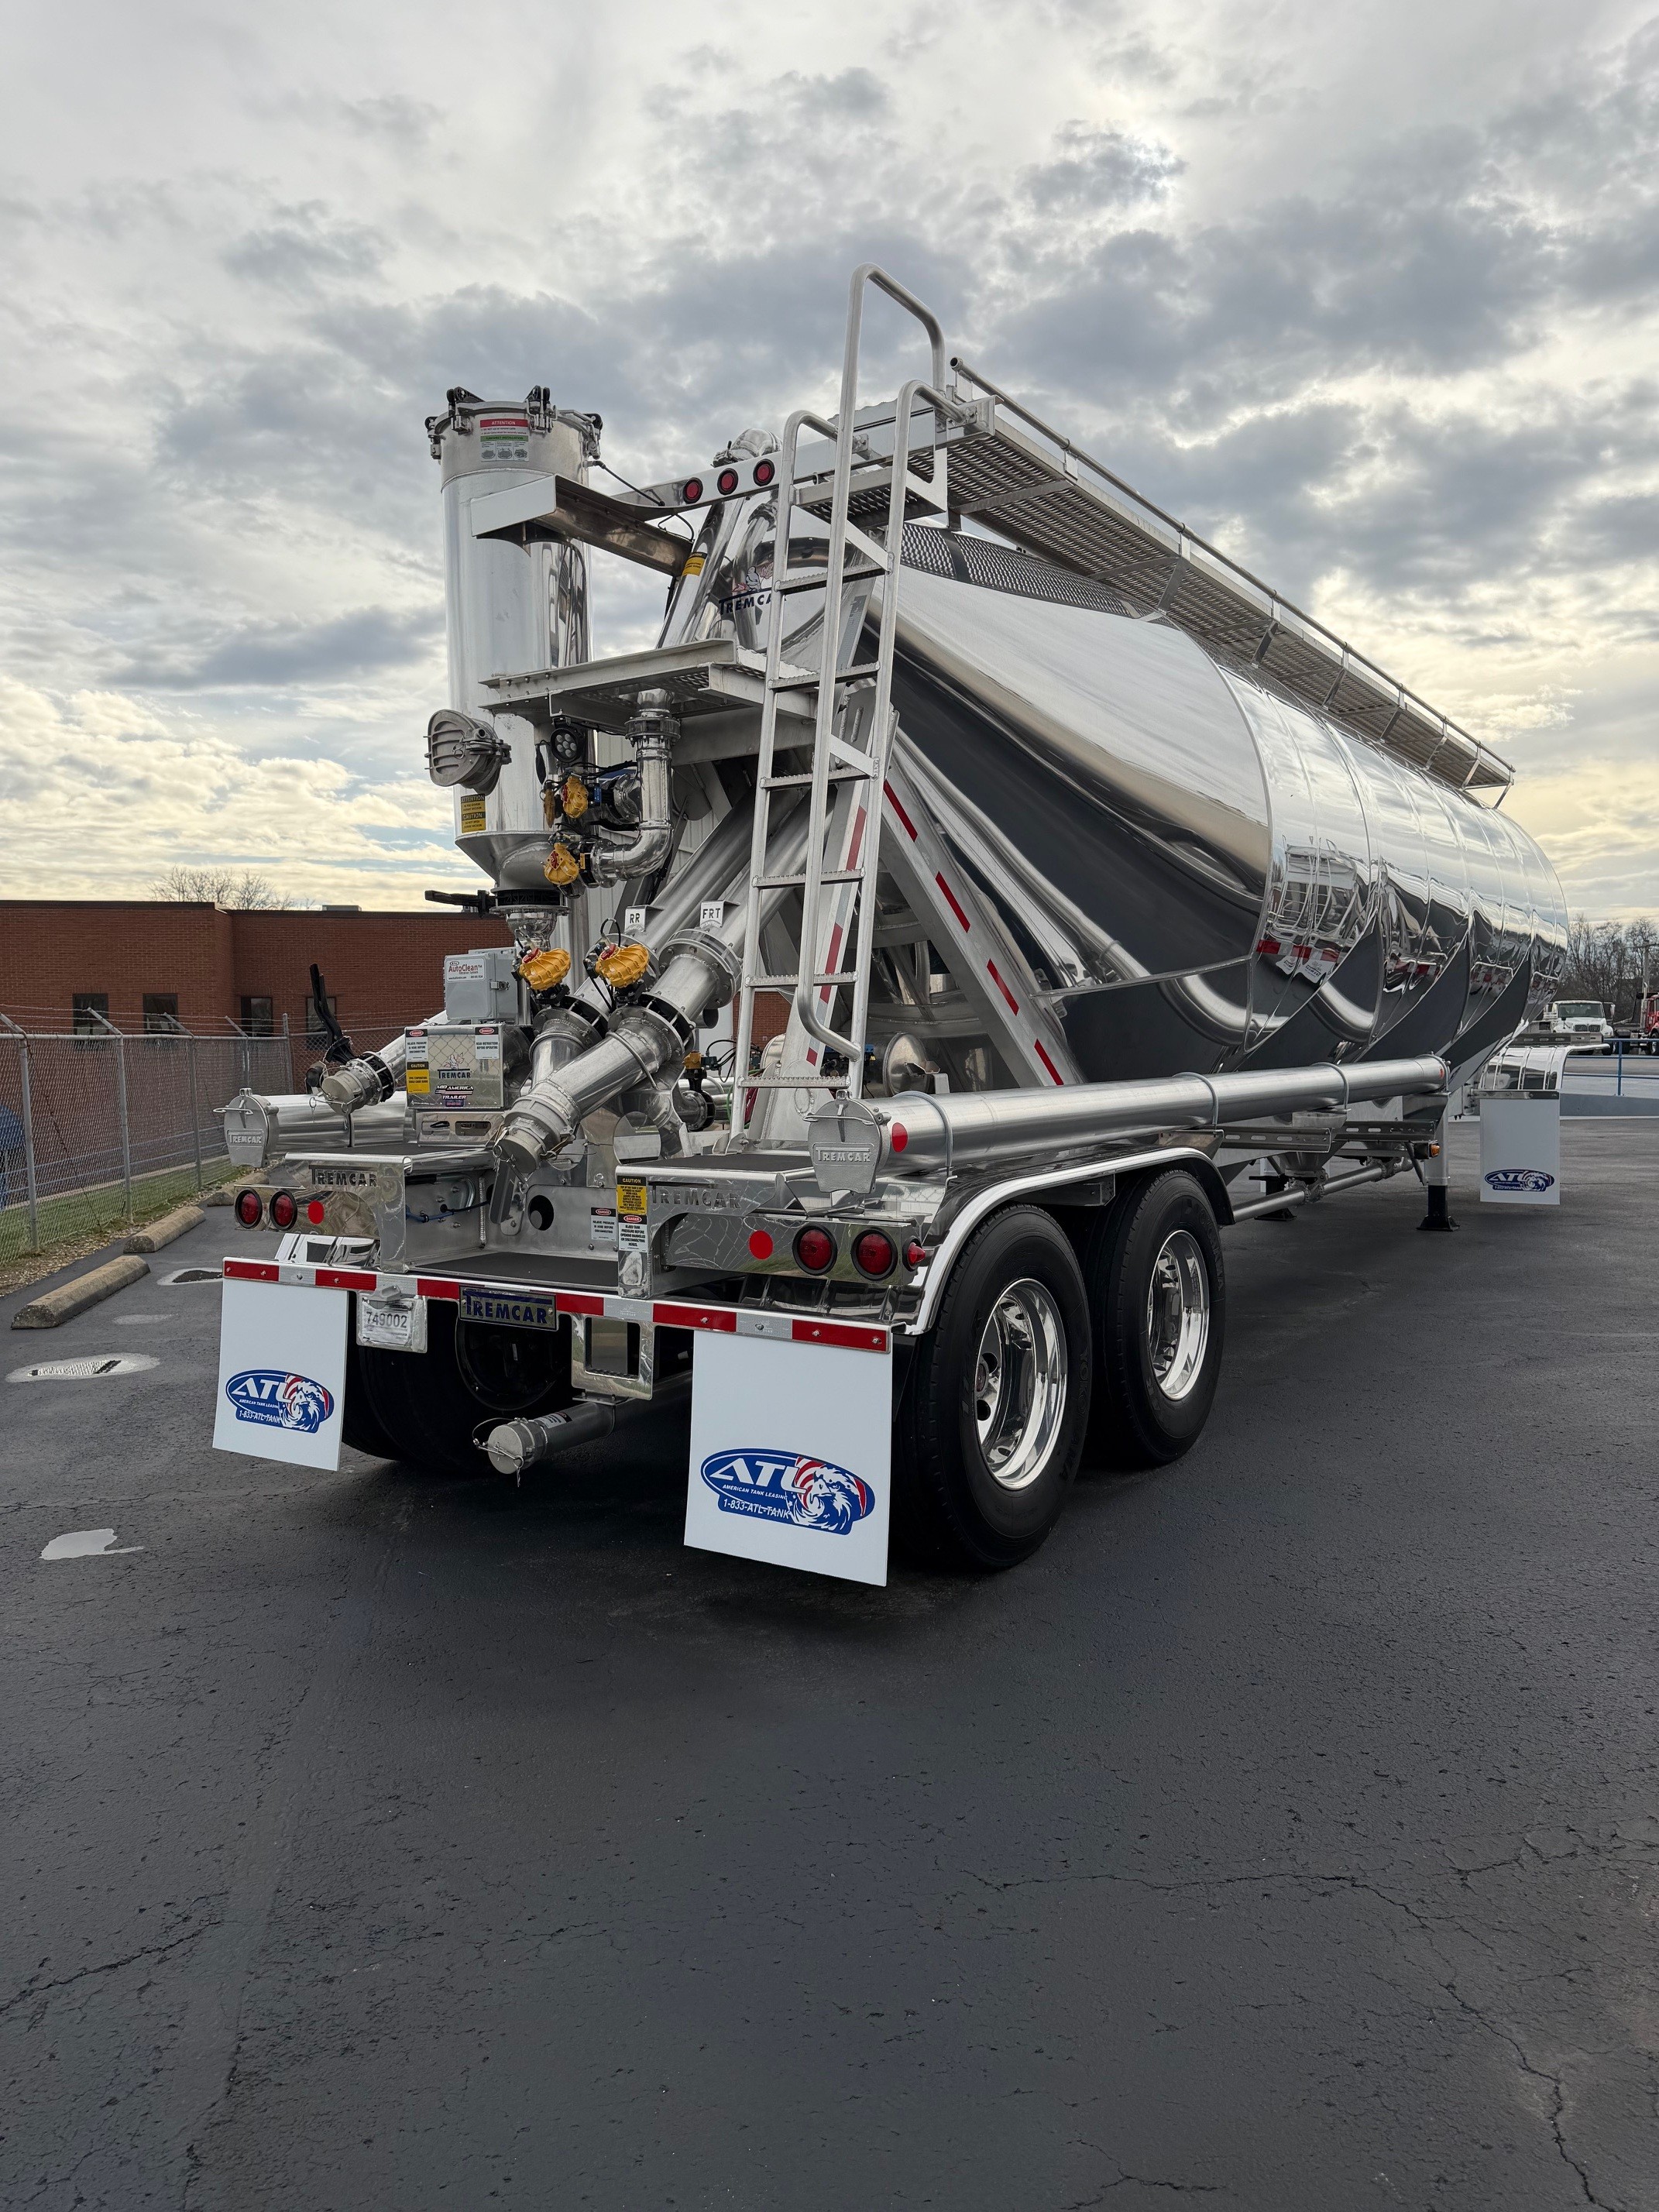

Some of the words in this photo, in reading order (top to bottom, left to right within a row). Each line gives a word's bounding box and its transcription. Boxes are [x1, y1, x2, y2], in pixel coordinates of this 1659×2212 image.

[719, 588, 786, 615] TREMCA
[630, 913, 641, 923] RR
[702, 908, 720, 919] FRT
[438, 1069, 471, 1079] TREMCAR
[229, 1132, 263, 1144] TREMCAR
[816, 1147, 871, 1162] TREMCAR
[308, 1165, 377, 1187] TREMCAR
[1489, 1173, 1527, 1182] ATL
[648, 1180, 741, 1209] TREMCAR
[463, 1290, 552, 1324] TREMCAR
[366, 1311, 407, 1328] 749002
[231, 1377, 292, 1403] ATL
[239, 1410, 280, 1424] 1-833-ATL-TANK
[709, 1458, 807, 1494] ATL
[723, 1484, 750, 1493] AMERICAN
[723, 1498, 789, 1520] 1-833-ATL-TANK
